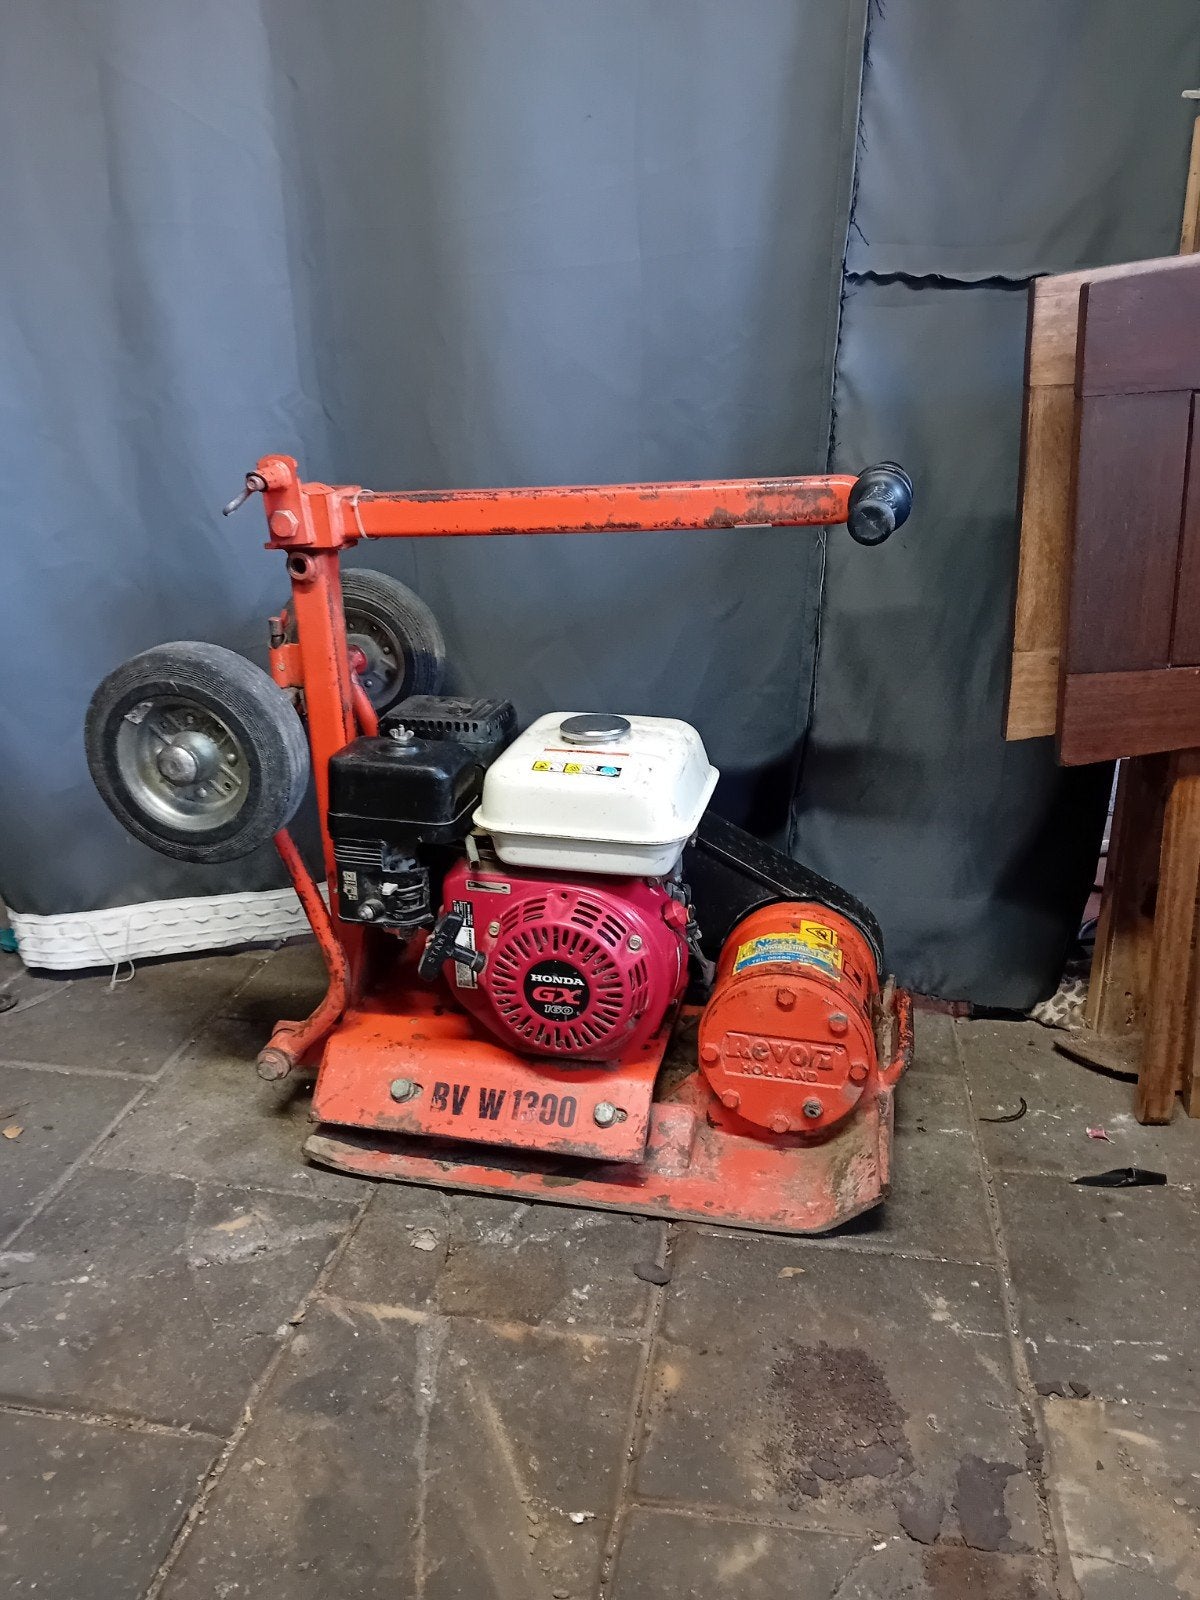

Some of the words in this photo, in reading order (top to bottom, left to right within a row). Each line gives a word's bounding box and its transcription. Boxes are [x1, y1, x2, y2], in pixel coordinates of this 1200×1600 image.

[428, 931, 448, 963] START
[530, 973, 585, 986] HONDA
[532, 986, 582, 1005] GX
[544, 1004, 574, 1015] 160
[741, 1061, 819, 1083] HOLLAND
[430, 1081, 470, 1116] BV
[478, 1087, 507, 1121] W
[511, 1089, 577, 1128] 1300
